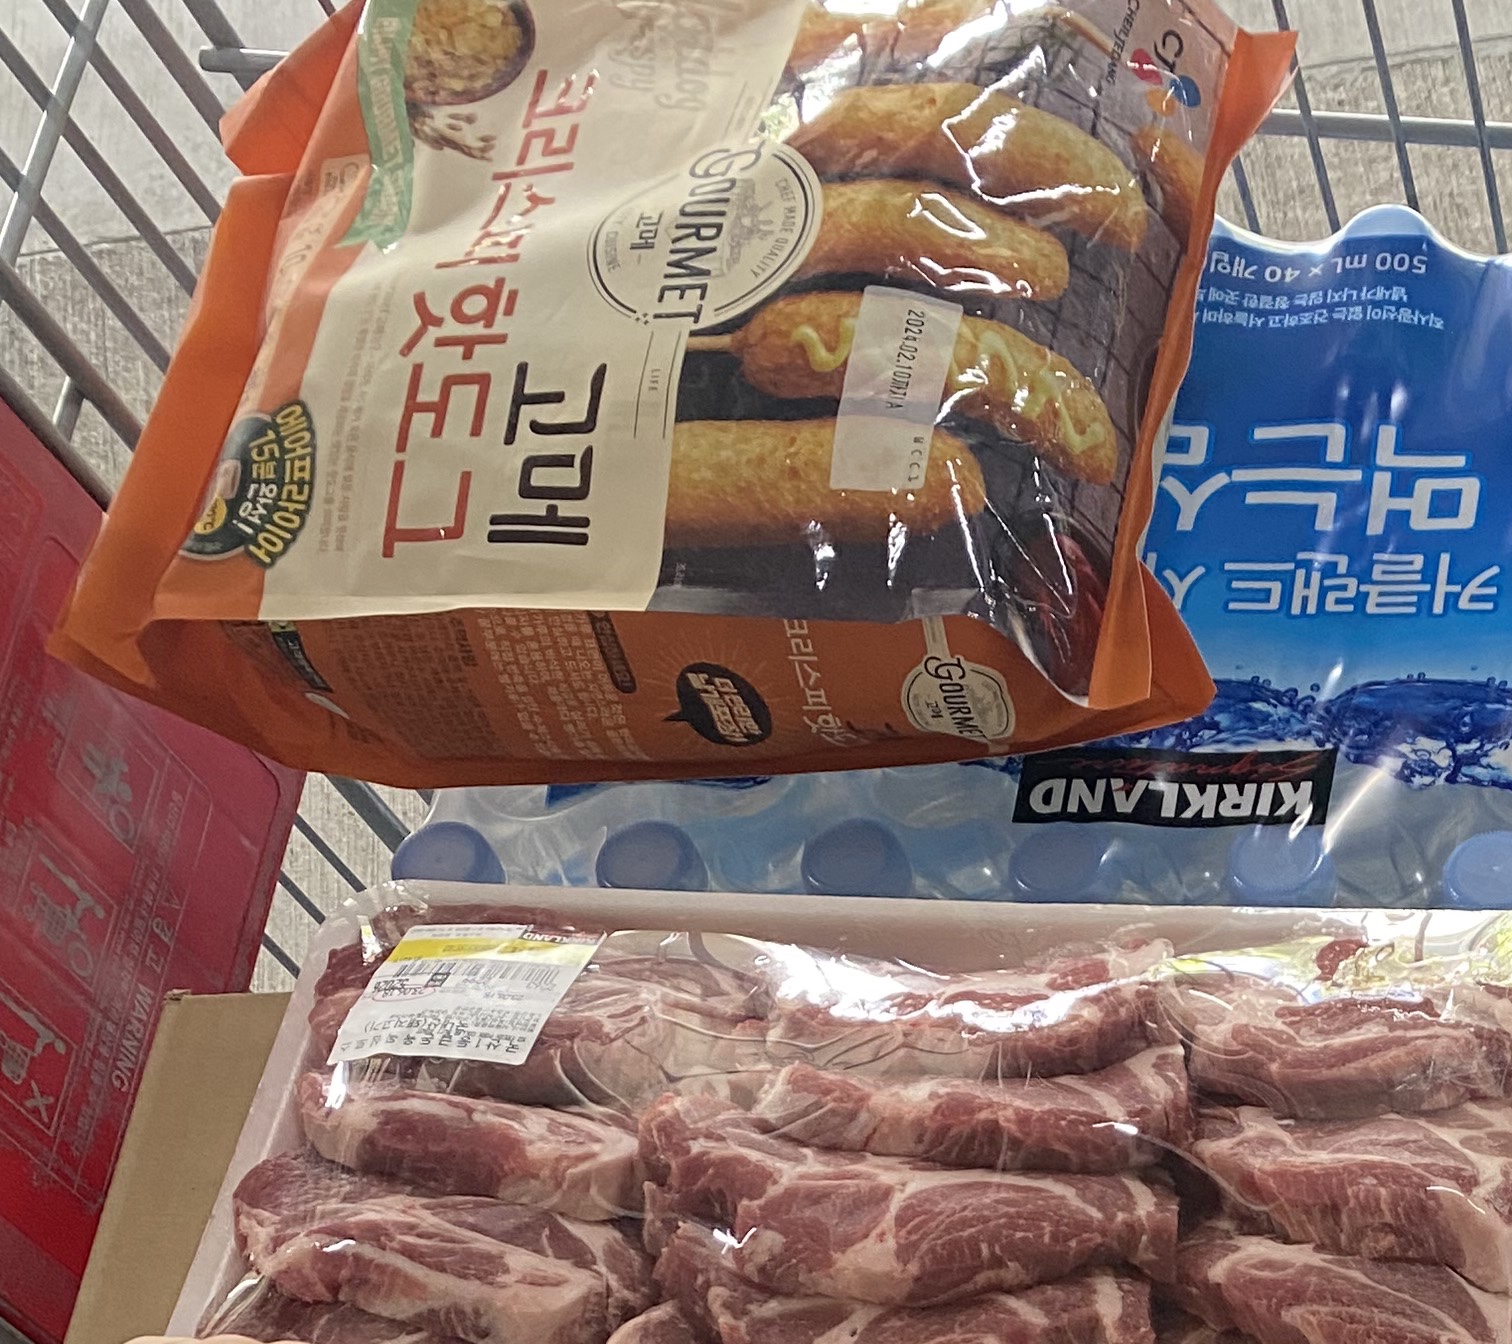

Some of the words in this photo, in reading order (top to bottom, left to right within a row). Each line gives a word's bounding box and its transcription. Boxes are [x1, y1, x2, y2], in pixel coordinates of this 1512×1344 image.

[1145, 25, 1188, 74] CJ
[436, 67, 601, 269] 크리스피
[652, 141, 764, 324] GOURMET
[780, 206, 796, 233] MADE
[749, 237, 788, 277] QUALITY
[1209, 251, 1257, 279] 개입
[1264, 265, 1300, 282] 40
[1330, 253, 1367, 273] mL
[1375, 252, 1427, 273] 500
[381, 278, 521, 559] 핫도그
[487, 361, 607, 543] 고메
[247, 402, 312, 562] 에어프라이어
[1223, 551, 1500, 615] 커클랜드
[1028, 780, 1315, 819] KIRKLAND
[108, 982, 154, 1093] WARNING
